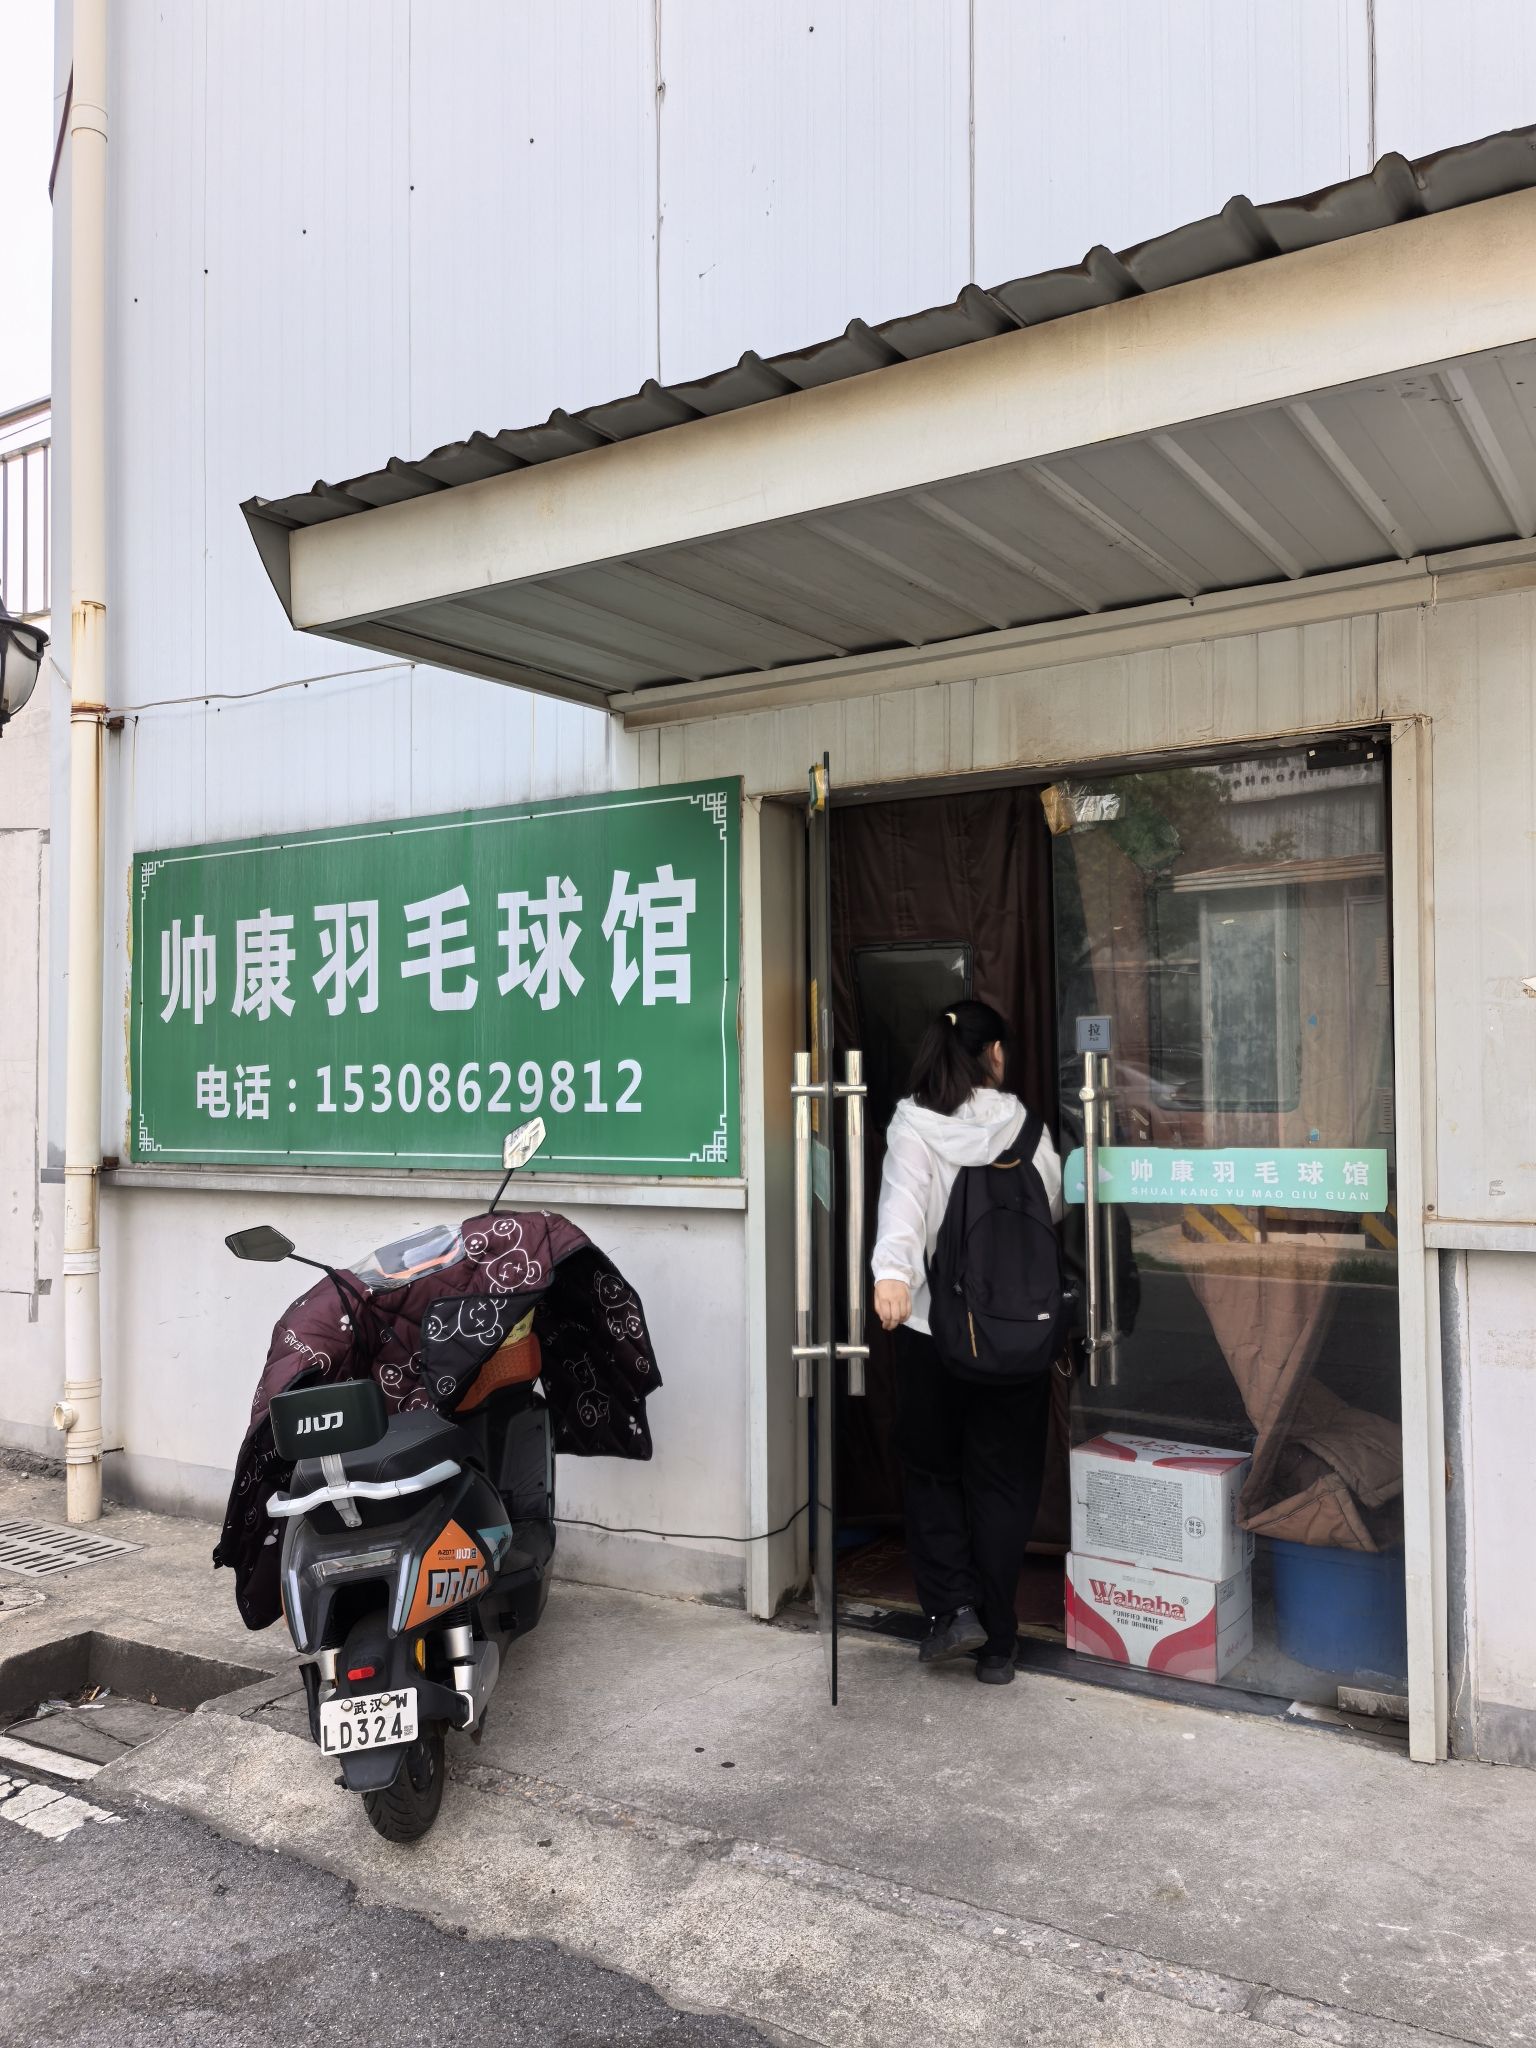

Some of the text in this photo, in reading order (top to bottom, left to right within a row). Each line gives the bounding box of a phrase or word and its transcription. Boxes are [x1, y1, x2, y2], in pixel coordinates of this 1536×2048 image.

[159, 864, 697, 1025] 帅康羽毛球馆
[1131, 1158, 1370, 1186] 帅康羽毛球馆
[1131, 1186, 1370, 1201] SHUAI KANG YU MAO QIU GUAN
[1089, 1578, 1187, 1622] Wahaha
[1113, 1609, 1164, 1625] PURIFIED WATER
[323, 1712, 403, 1753] LD324
